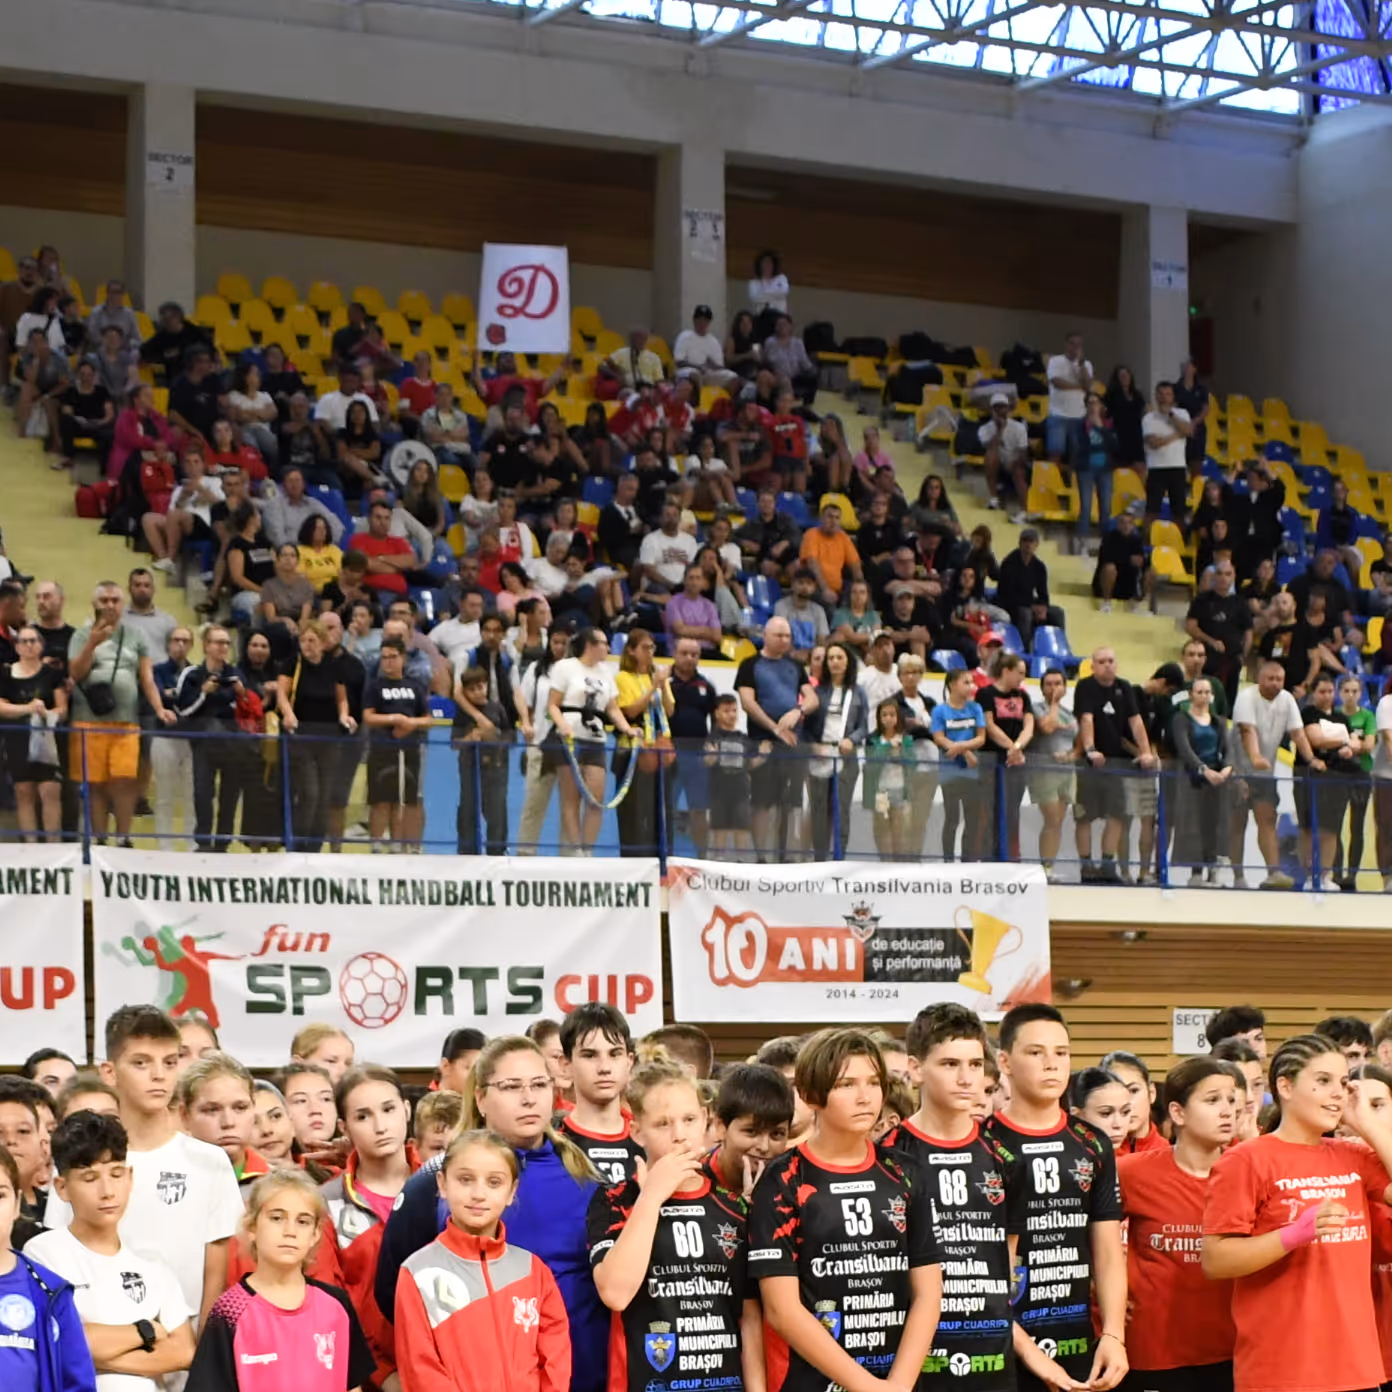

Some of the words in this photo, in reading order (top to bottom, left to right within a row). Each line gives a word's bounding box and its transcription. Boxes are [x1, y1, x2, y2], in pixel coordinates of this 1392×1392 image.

[497, 264, 559, 319] D
[101, 869, 180, 902] YOUTH
[187, 875, 373, 906] INTERNATIONAL
[378, 877, 496, 908] HANDBALL
[502, 880, 654, 909] TOURNAMENT
[686, 873, 751, 892] Clubul
[758, 877, 826, 896] Sportiv
[831, 876, 954, 895] Transilvania
[960, 878, 1029, 896] Brasov
[251, 924, 331, 957] fun
[706, 916, 769, 981] 10
[778, 938, 856, 972] ANI
[871, 938, 888, 952] de
[553, 973, 655, 1015] CUP
[826, 989, 858, 999] 2014
[869, 988, 900, 999] 2024
[1175, 1014, 1208, 1027] SECT
[1197, 1033, 1207, 1048] 8
[1032, 1156, 1061, 1194] 63
[938, 1169, 969, 1206] 68
[841, 1197, 874, 1237] 53
[955, 1211, 993, 1220] SPORTIV
[822, 1242, 859, 1254] CLUBUL
[861, 1240, 899, 1251] SPORTIV
[1028, 1245, 1079, 1265] PRIMĂRIA
[653, 1265, 691, 1276] CLUBUL
[810, 1252, 909, 1277] Transilvania
[848, 1277, 884, 1288] BRAȘOV
[843, 1291, 895, 1311] PRIMĂRIA
[1030, 1283, 1072, 1303] BRAȘOV
[940, 1297, 986, 1316] BRAȘOV
[1021, 1307, 1050, 1320] GRUP
[936, 1321, 962, 1330] RUP
[844, 1331, 886, 1351] BRAȘOV
[679, 1354, 723, 1374] BRAȘOV
[670, 1379, 702, 1390] GRUP
